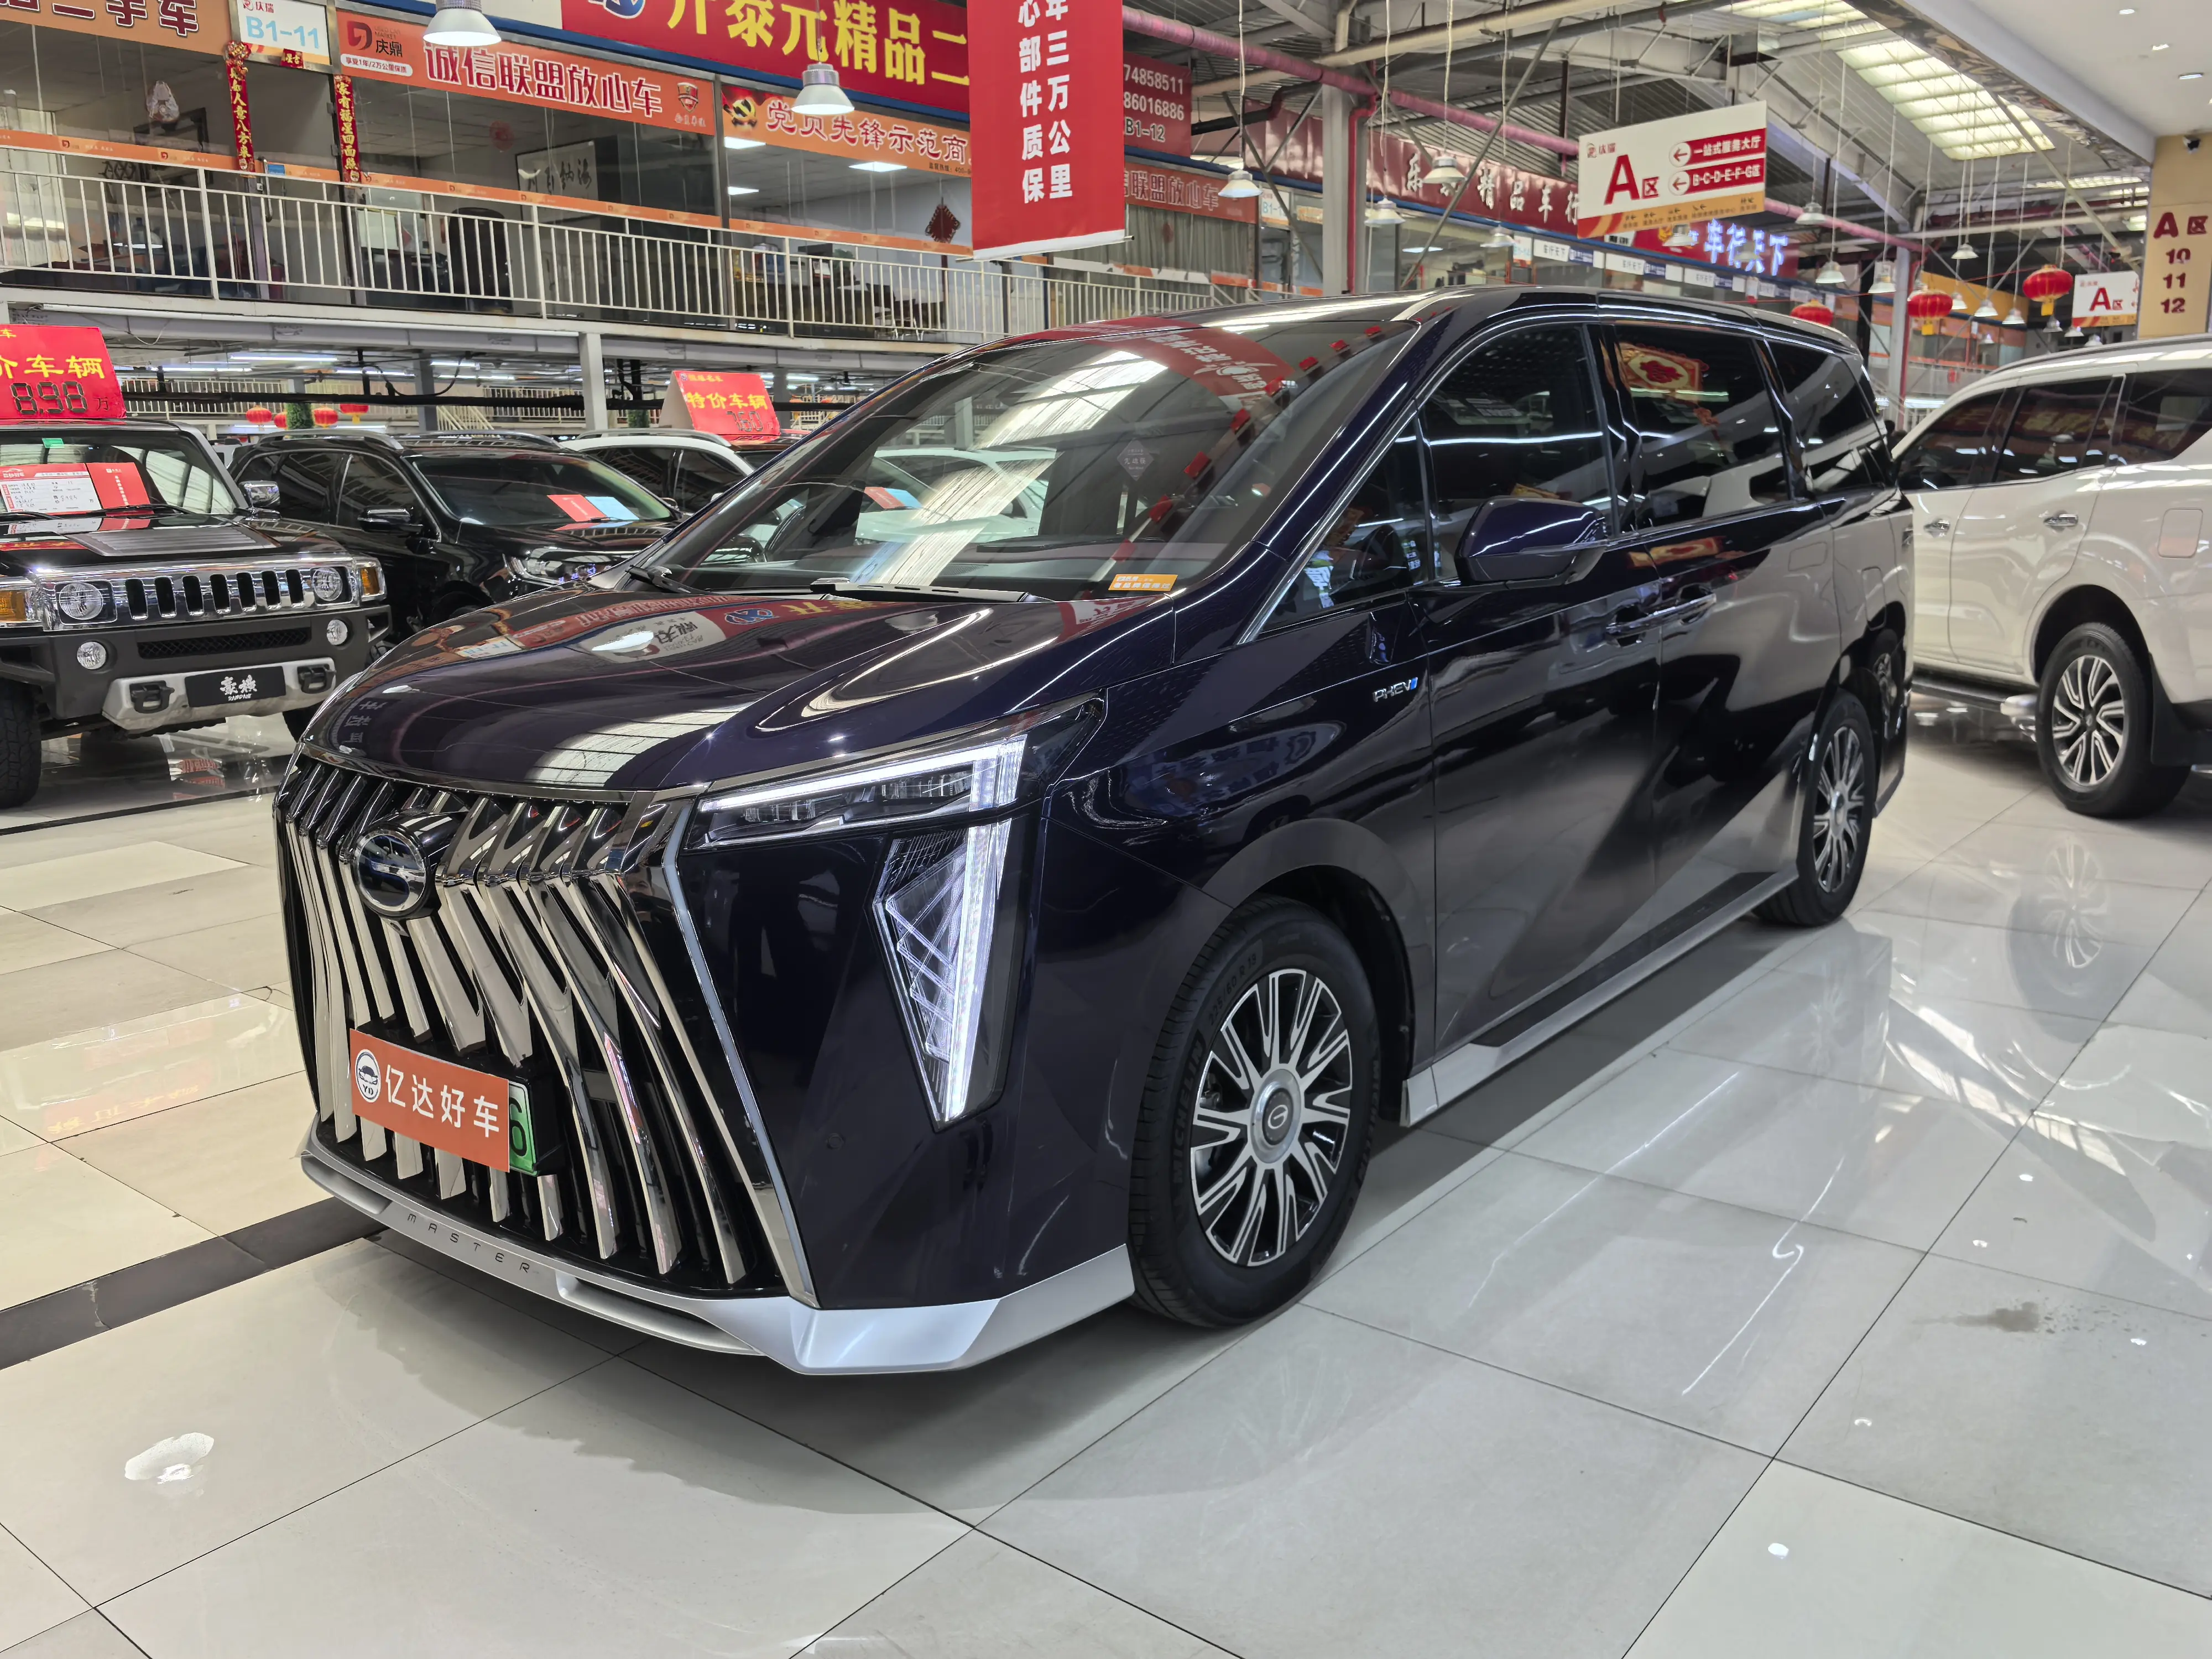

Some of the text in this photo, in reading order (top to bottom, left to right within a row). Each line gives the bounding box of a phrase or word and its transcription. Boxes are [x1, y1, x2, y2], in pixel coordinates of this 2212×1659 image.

[246, 15, 319, 49] B1-11
[376, 39, 403, 57] 庆鼎
[423, 42, 663, 118] 诚信联盟放心车
[1124, 64, 1183, 95] 74858511
[1124, 91, 1185, 121] 86016886
[1124, 117, 1166, 143] B1-12
[2166, 248, 2191, 265] 10
[2162, 272, 2187, 289] 11
[2161, 297, 2185, 314] 12
[95, 397, 109, 411] 万
[686, 392, 768, 410] 特价车辆
[1372, 679, 1412, 702] PHEV
[362, 1083, 375, 1096] YD
[385, 1064, 499, 1138] 亿达好车
[1172, 1039, 1202, 1185] MICHELIN
[408, 1213, 530, 1274] MASTER
